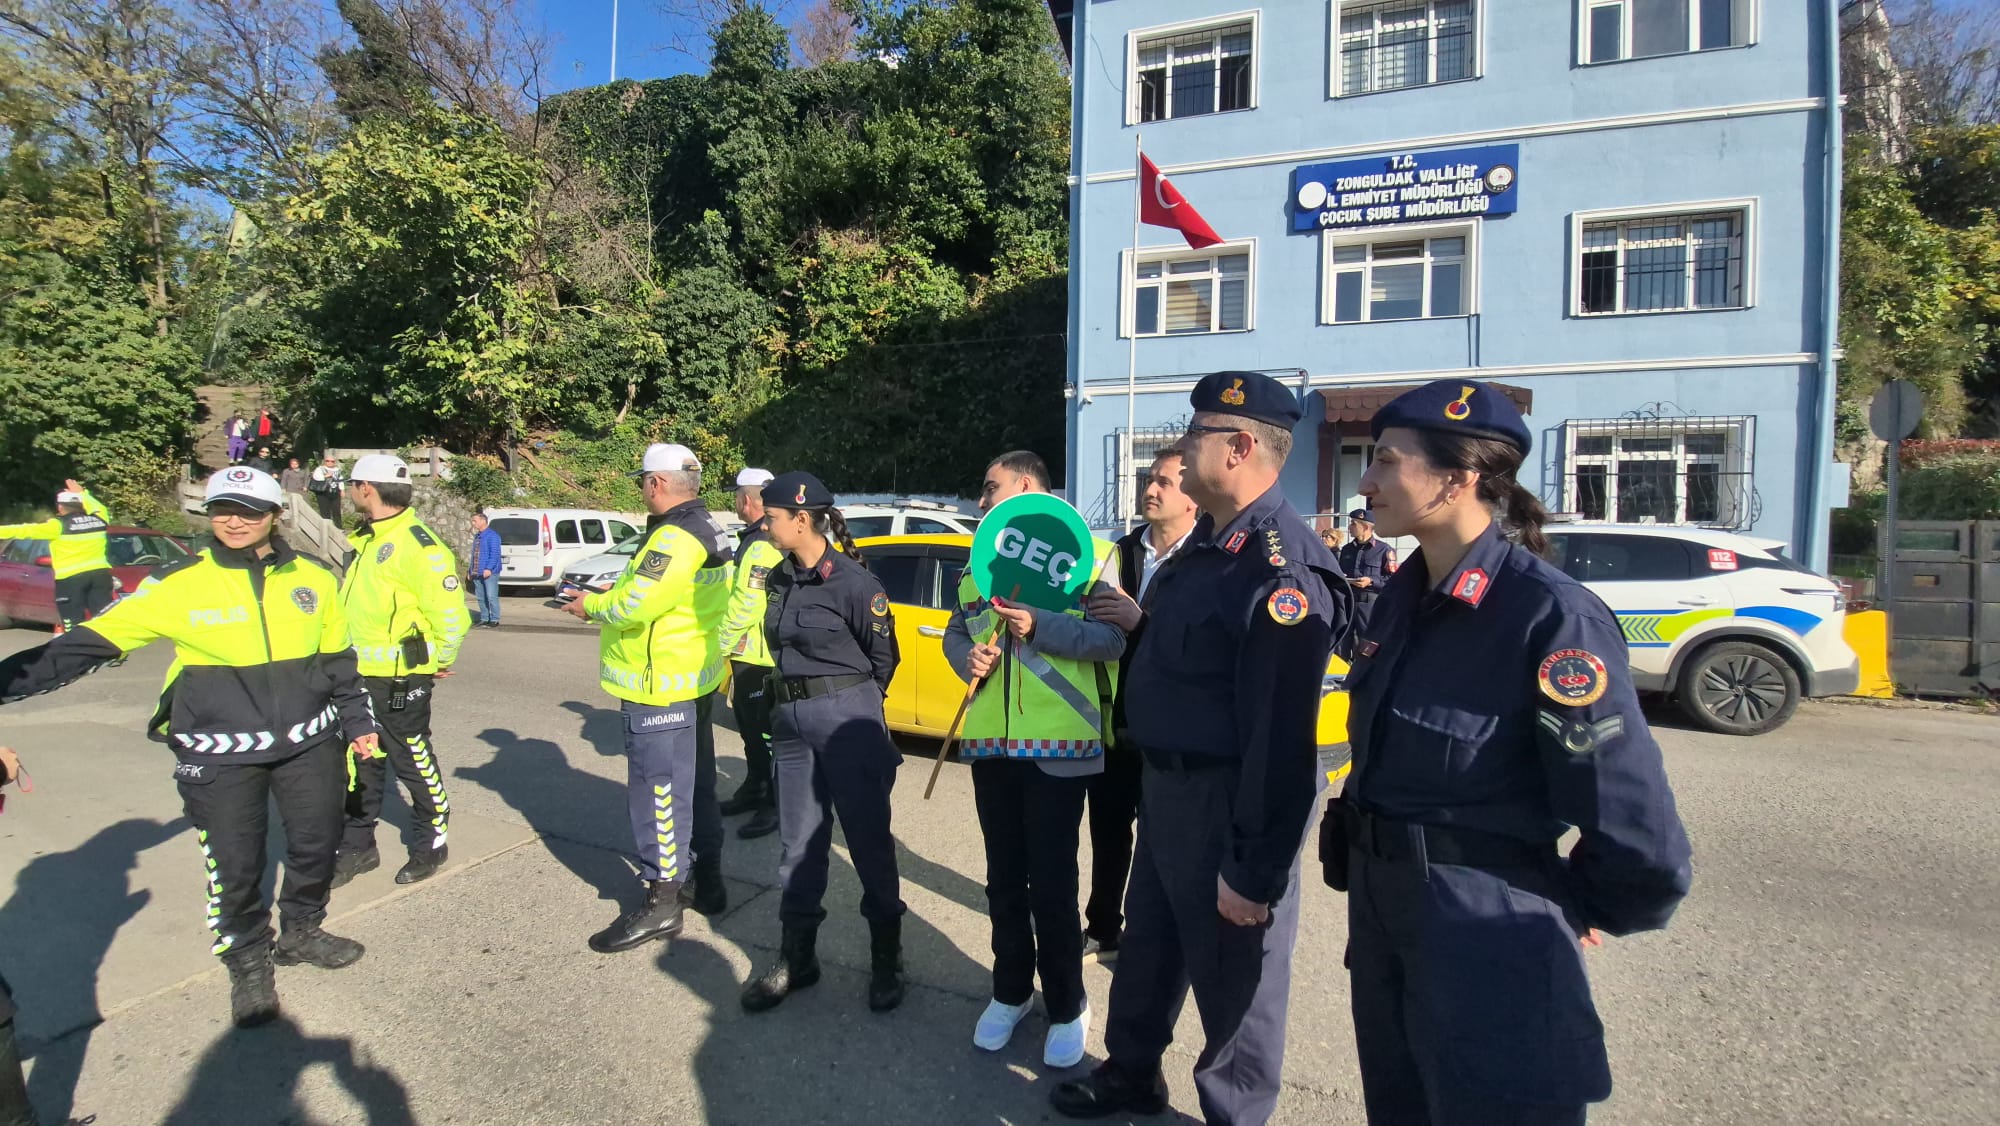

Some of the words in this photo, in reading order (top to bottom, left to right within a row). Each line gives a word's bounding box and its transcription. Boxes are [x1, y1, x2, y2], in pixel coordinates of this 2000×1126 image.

[1392, 155, 1417, 169] T.C.
[1336, 171, 1414, 191] ZONGULDAK
[1327, 193, 1338, 208] İL
[1342, 189, 1397, 207] EMNİYET
[1401, 178, 1483, 201] MÜDÜRLÜĞÜ
[1320, 209, 1363, 226] ÇOCUK
[1367, 206, 1400, 222] ŞUBE
[1406, 195, 1490, 217] MÜDÜRLÜĞÜ
[994, 527, 1077, 588] GEÇ
[1711, 551, 1732, 562] 112
[641, 712, 685, 727] JANDARMA
